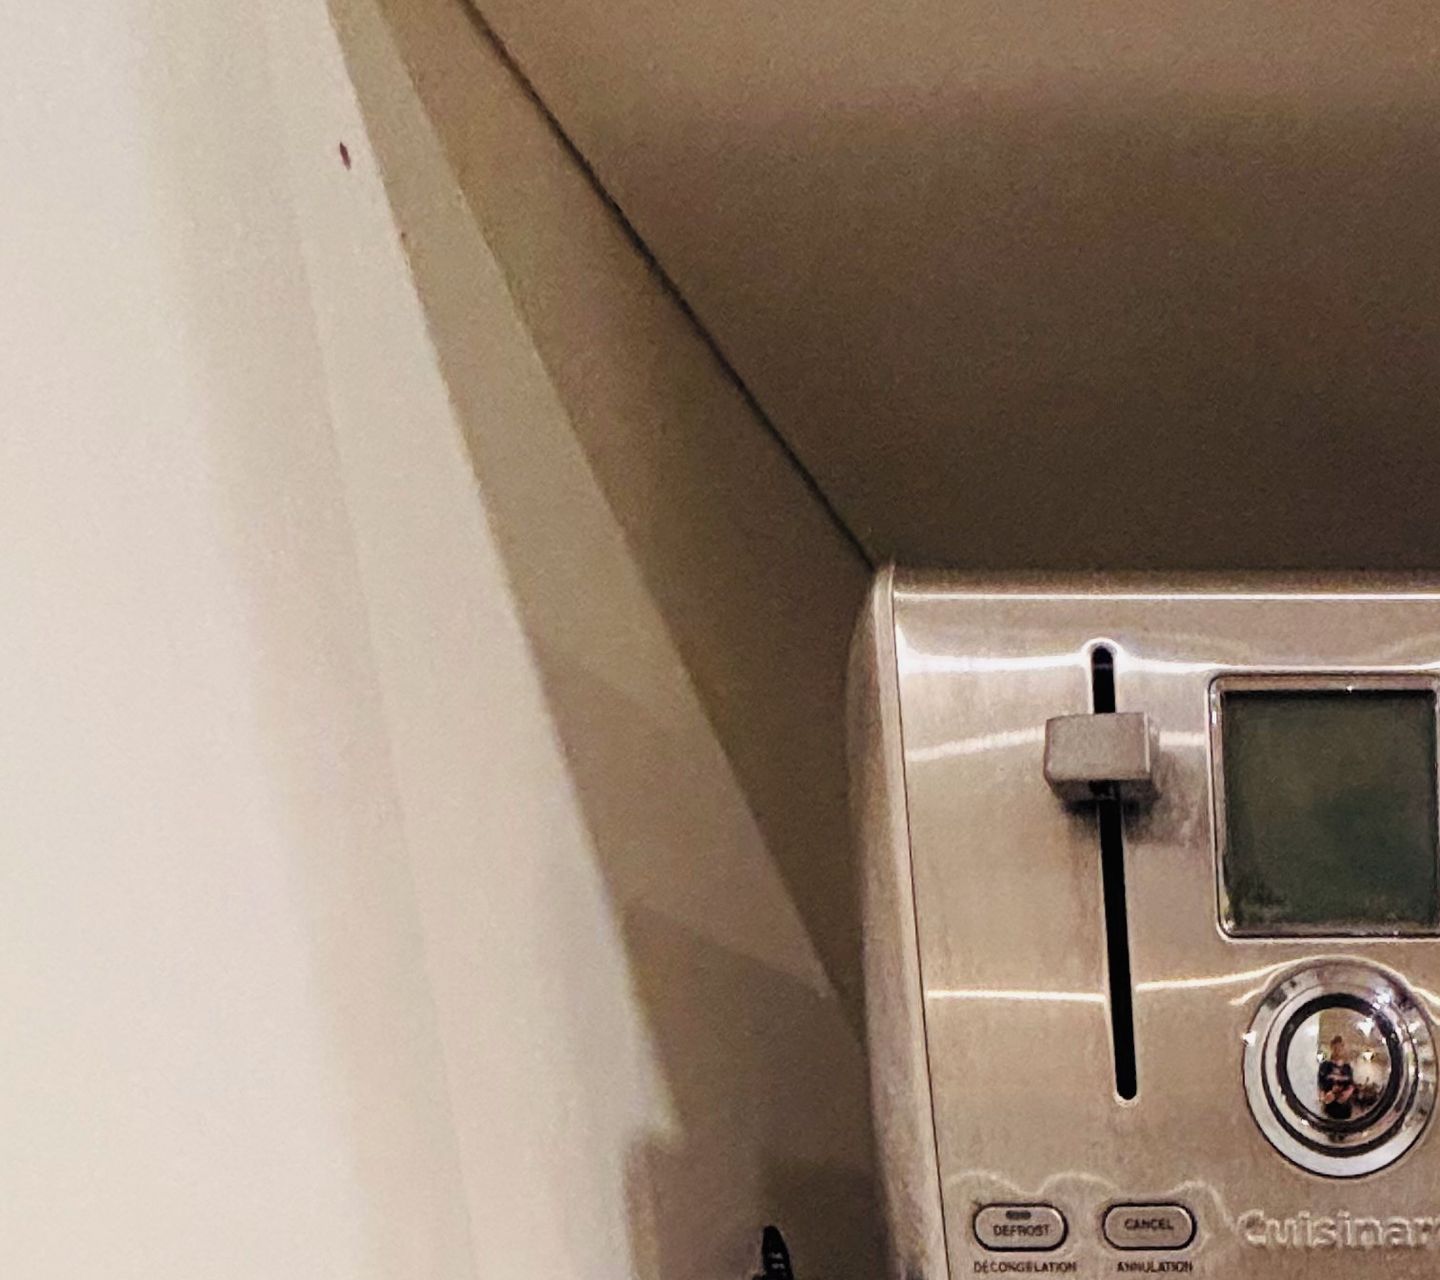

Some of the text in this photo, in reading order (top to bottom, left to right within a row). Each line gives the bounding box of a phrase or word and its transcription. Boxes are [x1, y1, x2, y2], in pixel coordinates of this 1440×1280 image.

[993, 1224, 1050, 1237] DEFROST
[1125, 1218, 1174, 1231] CANCEL
[1117, 1260, 1192, 1273] ANNULATION
